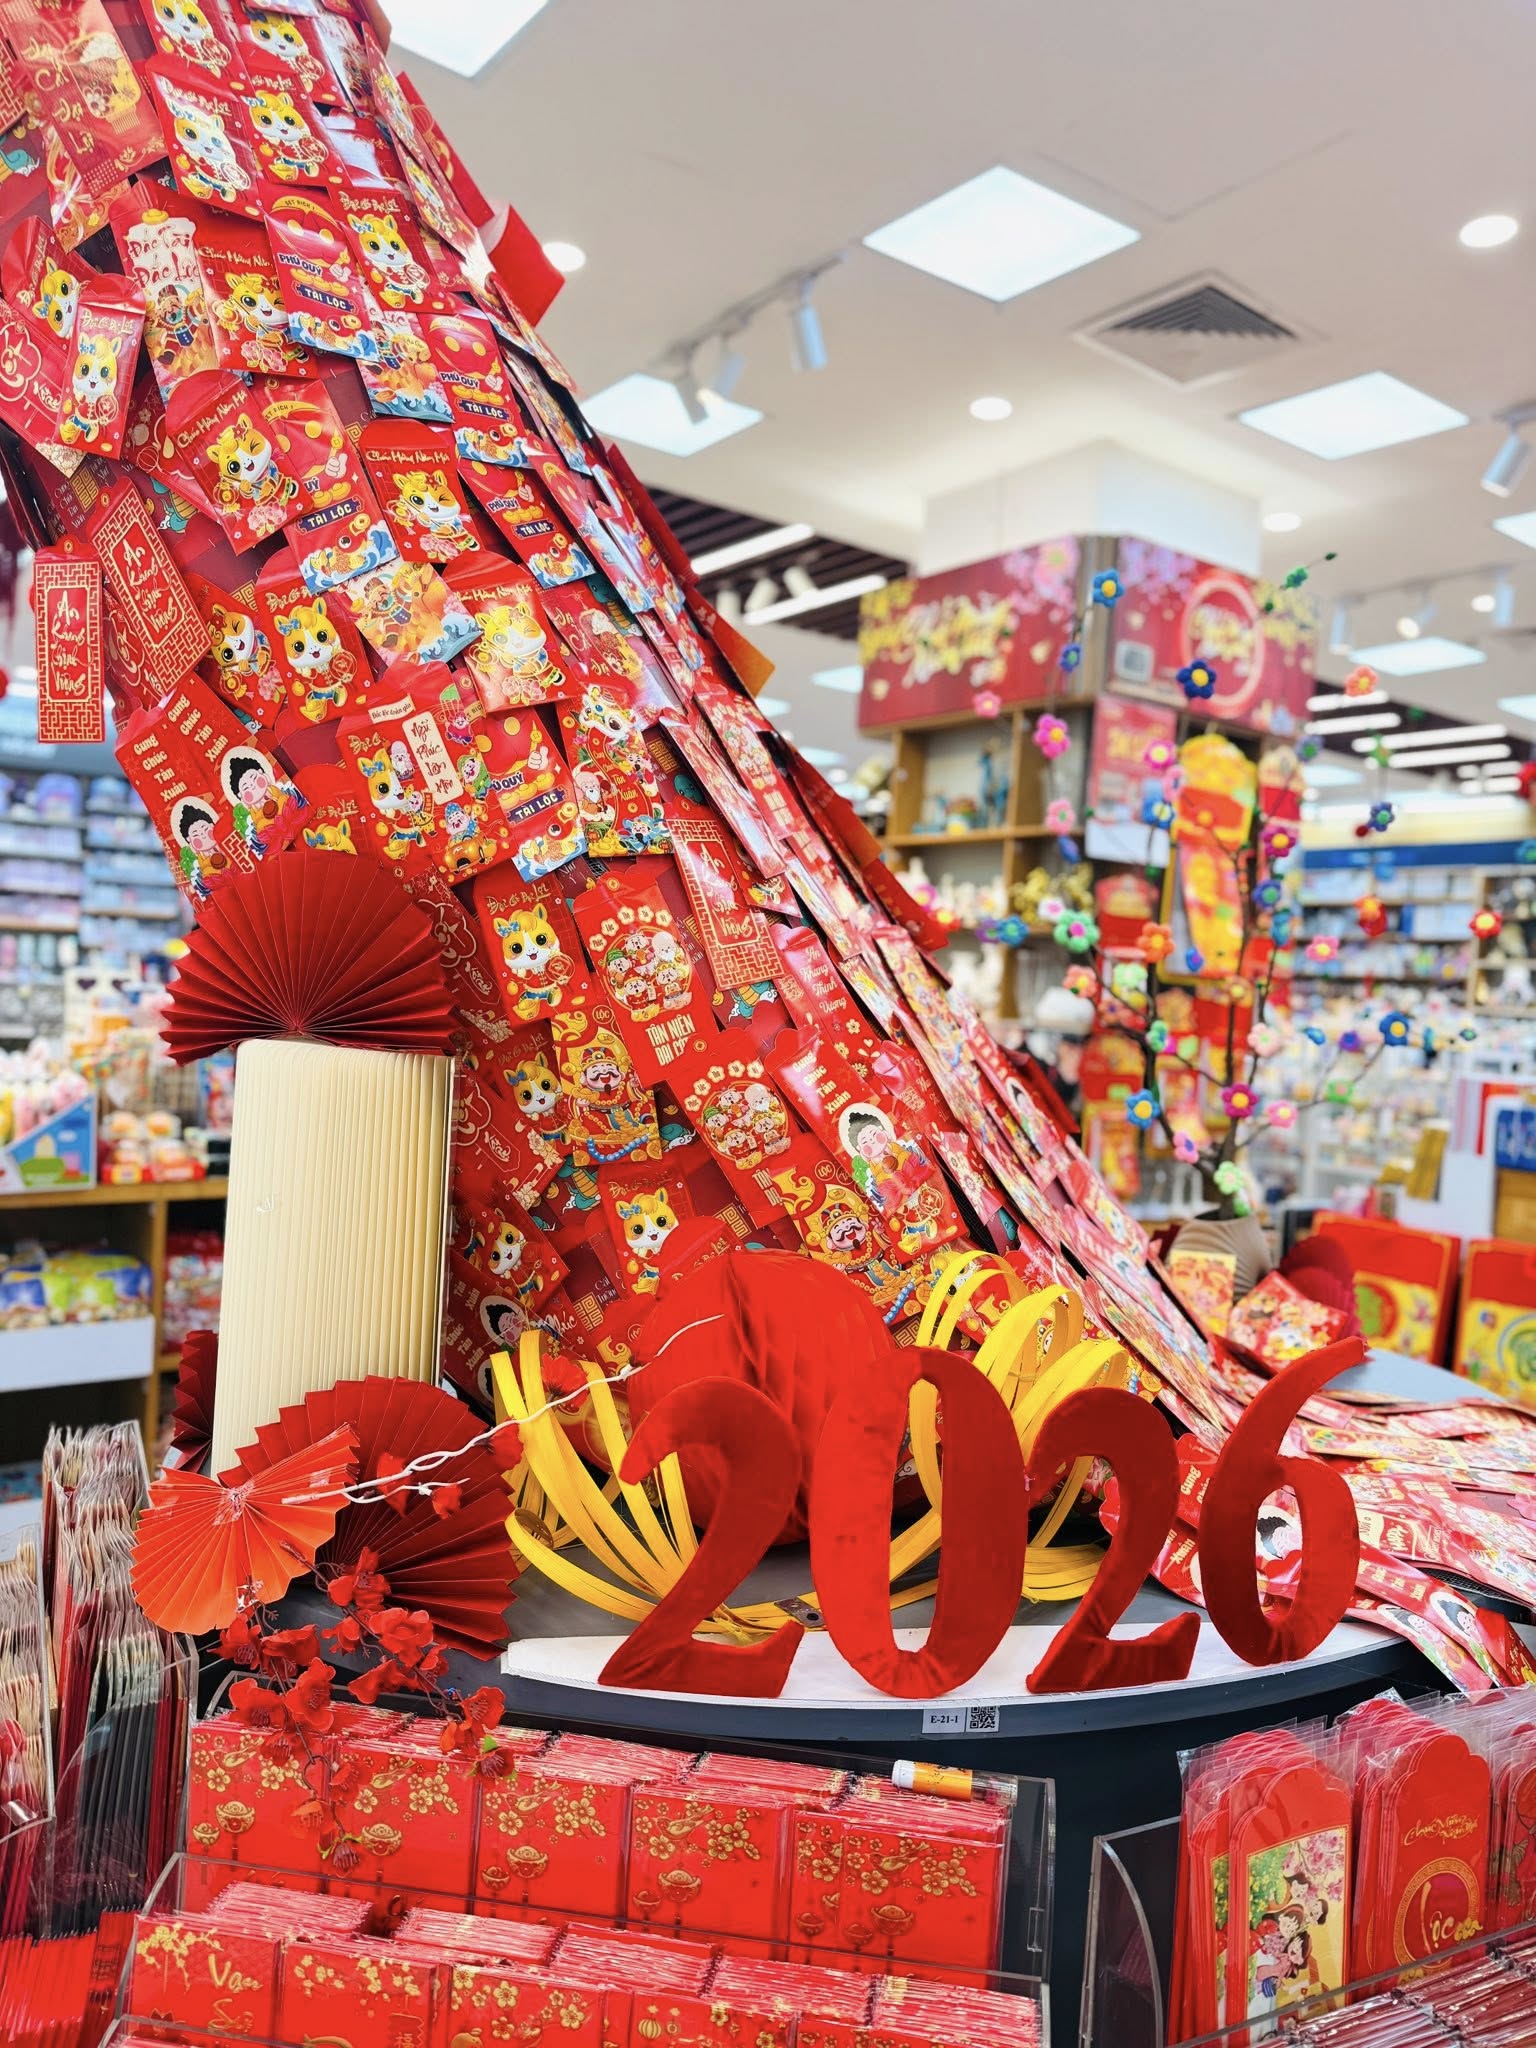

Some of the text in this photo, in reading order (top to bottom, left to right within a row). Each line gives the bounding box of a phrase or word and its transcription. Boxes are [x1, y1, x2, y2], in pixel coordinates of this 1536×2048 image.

[279, 253, 300, 266] PHÚ
[302, 260, 323, 275] QUÝ
[305, 288, 347, 310] TÀI LỘC
[440, 371, 480, 388] PHÚ QUÝ
[466, 403, 504, 418] TÀI LỘC
[304, 477, 320, 493] UÝ
[488, 496, 520, 511] PHÚ QUÝ
[308, 504, 352, 528] TÀI LỘC
[521, 519, 552, 536] TÀI LỘC
[57, 590, 80, 626] An
[179, 708, 202, 736] Chúc
[134, 734, 159, 756] Cung
[194, 724, 213, 745] Tân
[205, 734, 229, 762] Xuân
[142, 750, 168, 771] Chúc
[154, 767, 175, 785] Tân
[502, 773, 524, 790] QUÝ
[160, 781, 188, 803] Xuân
[515, 793, 559, 820] TÀI LỘC
[595, 1009, 610, 1019] LỘC
[645, 1013, 696, 1048] TÂN NIÊN
[654, 1043, 675, 1067] ĐẠI
[817, 1080, 837, 1099] Tân
[824, 1091, 851, 1115] Xuân
[819, 1165, 832, 1176] LỘC
[1179, 1464, 1201, 1496] Cung
[599, 1338, 1366, 1698] 2026
[1170, 1538, 1196, 1565] Xuân
[930, 1714, 959, 1724] E-21-1
[1421, 1881, 1455, 1954] Lộc
